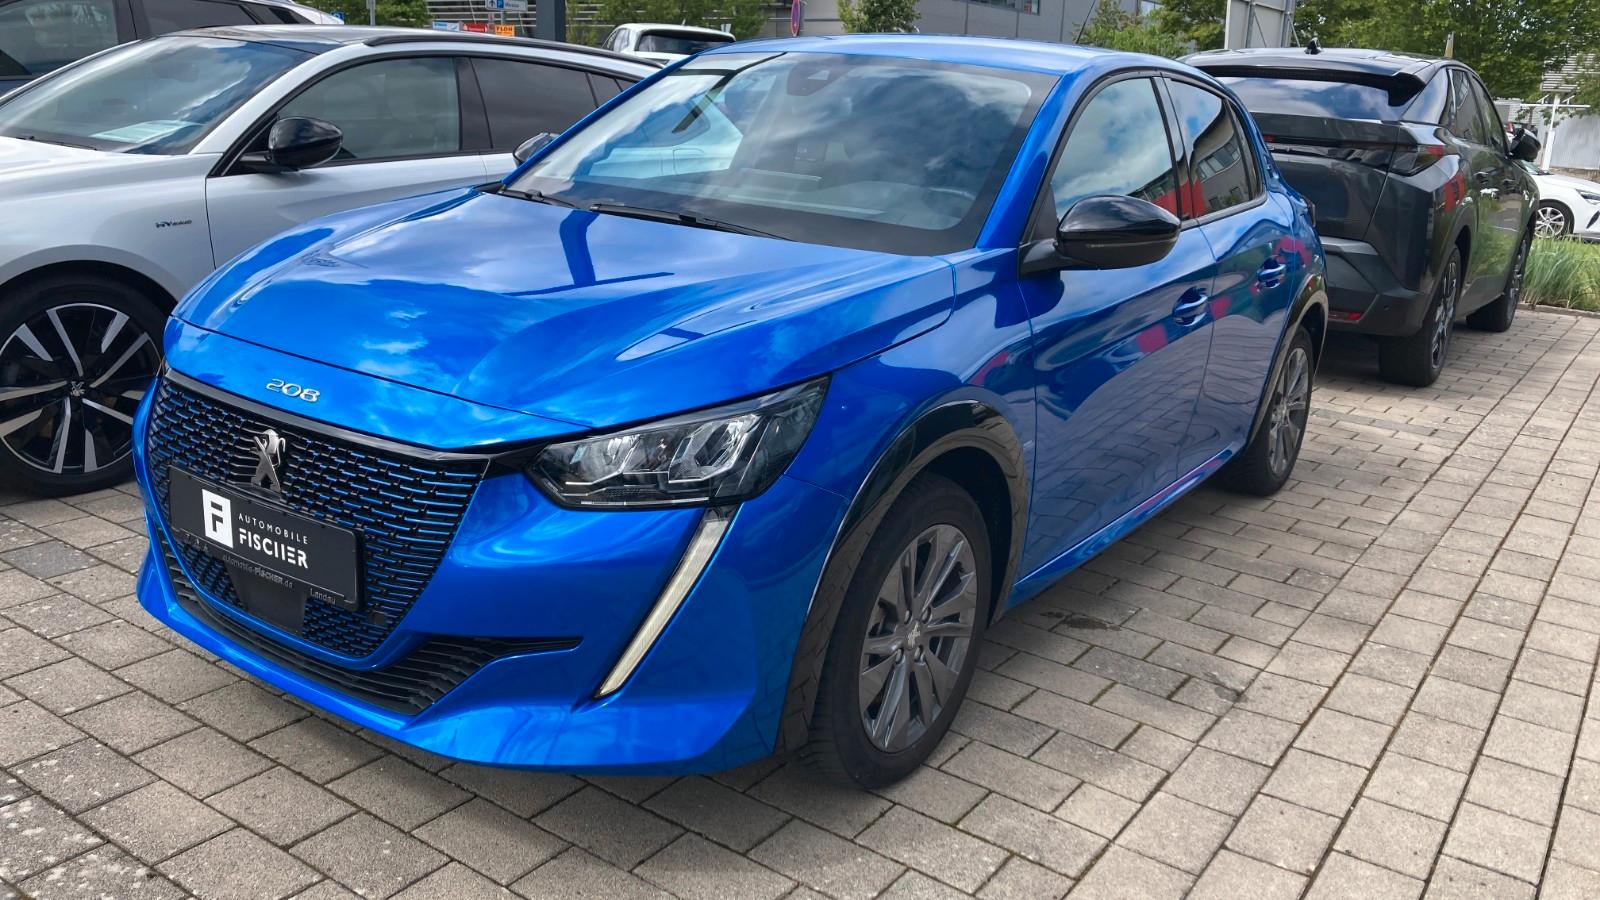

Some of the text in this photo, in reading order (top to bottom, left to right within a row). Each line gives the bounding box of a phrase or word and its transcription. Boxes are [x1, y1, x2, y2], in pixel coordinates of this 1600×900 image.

[266, 378, 321, 402] 208
[238, 512, 309, 545] AUTOMOBILE
[238, 527, 309, 569] FISCHER
[310, 587, 336, 605] Landau
